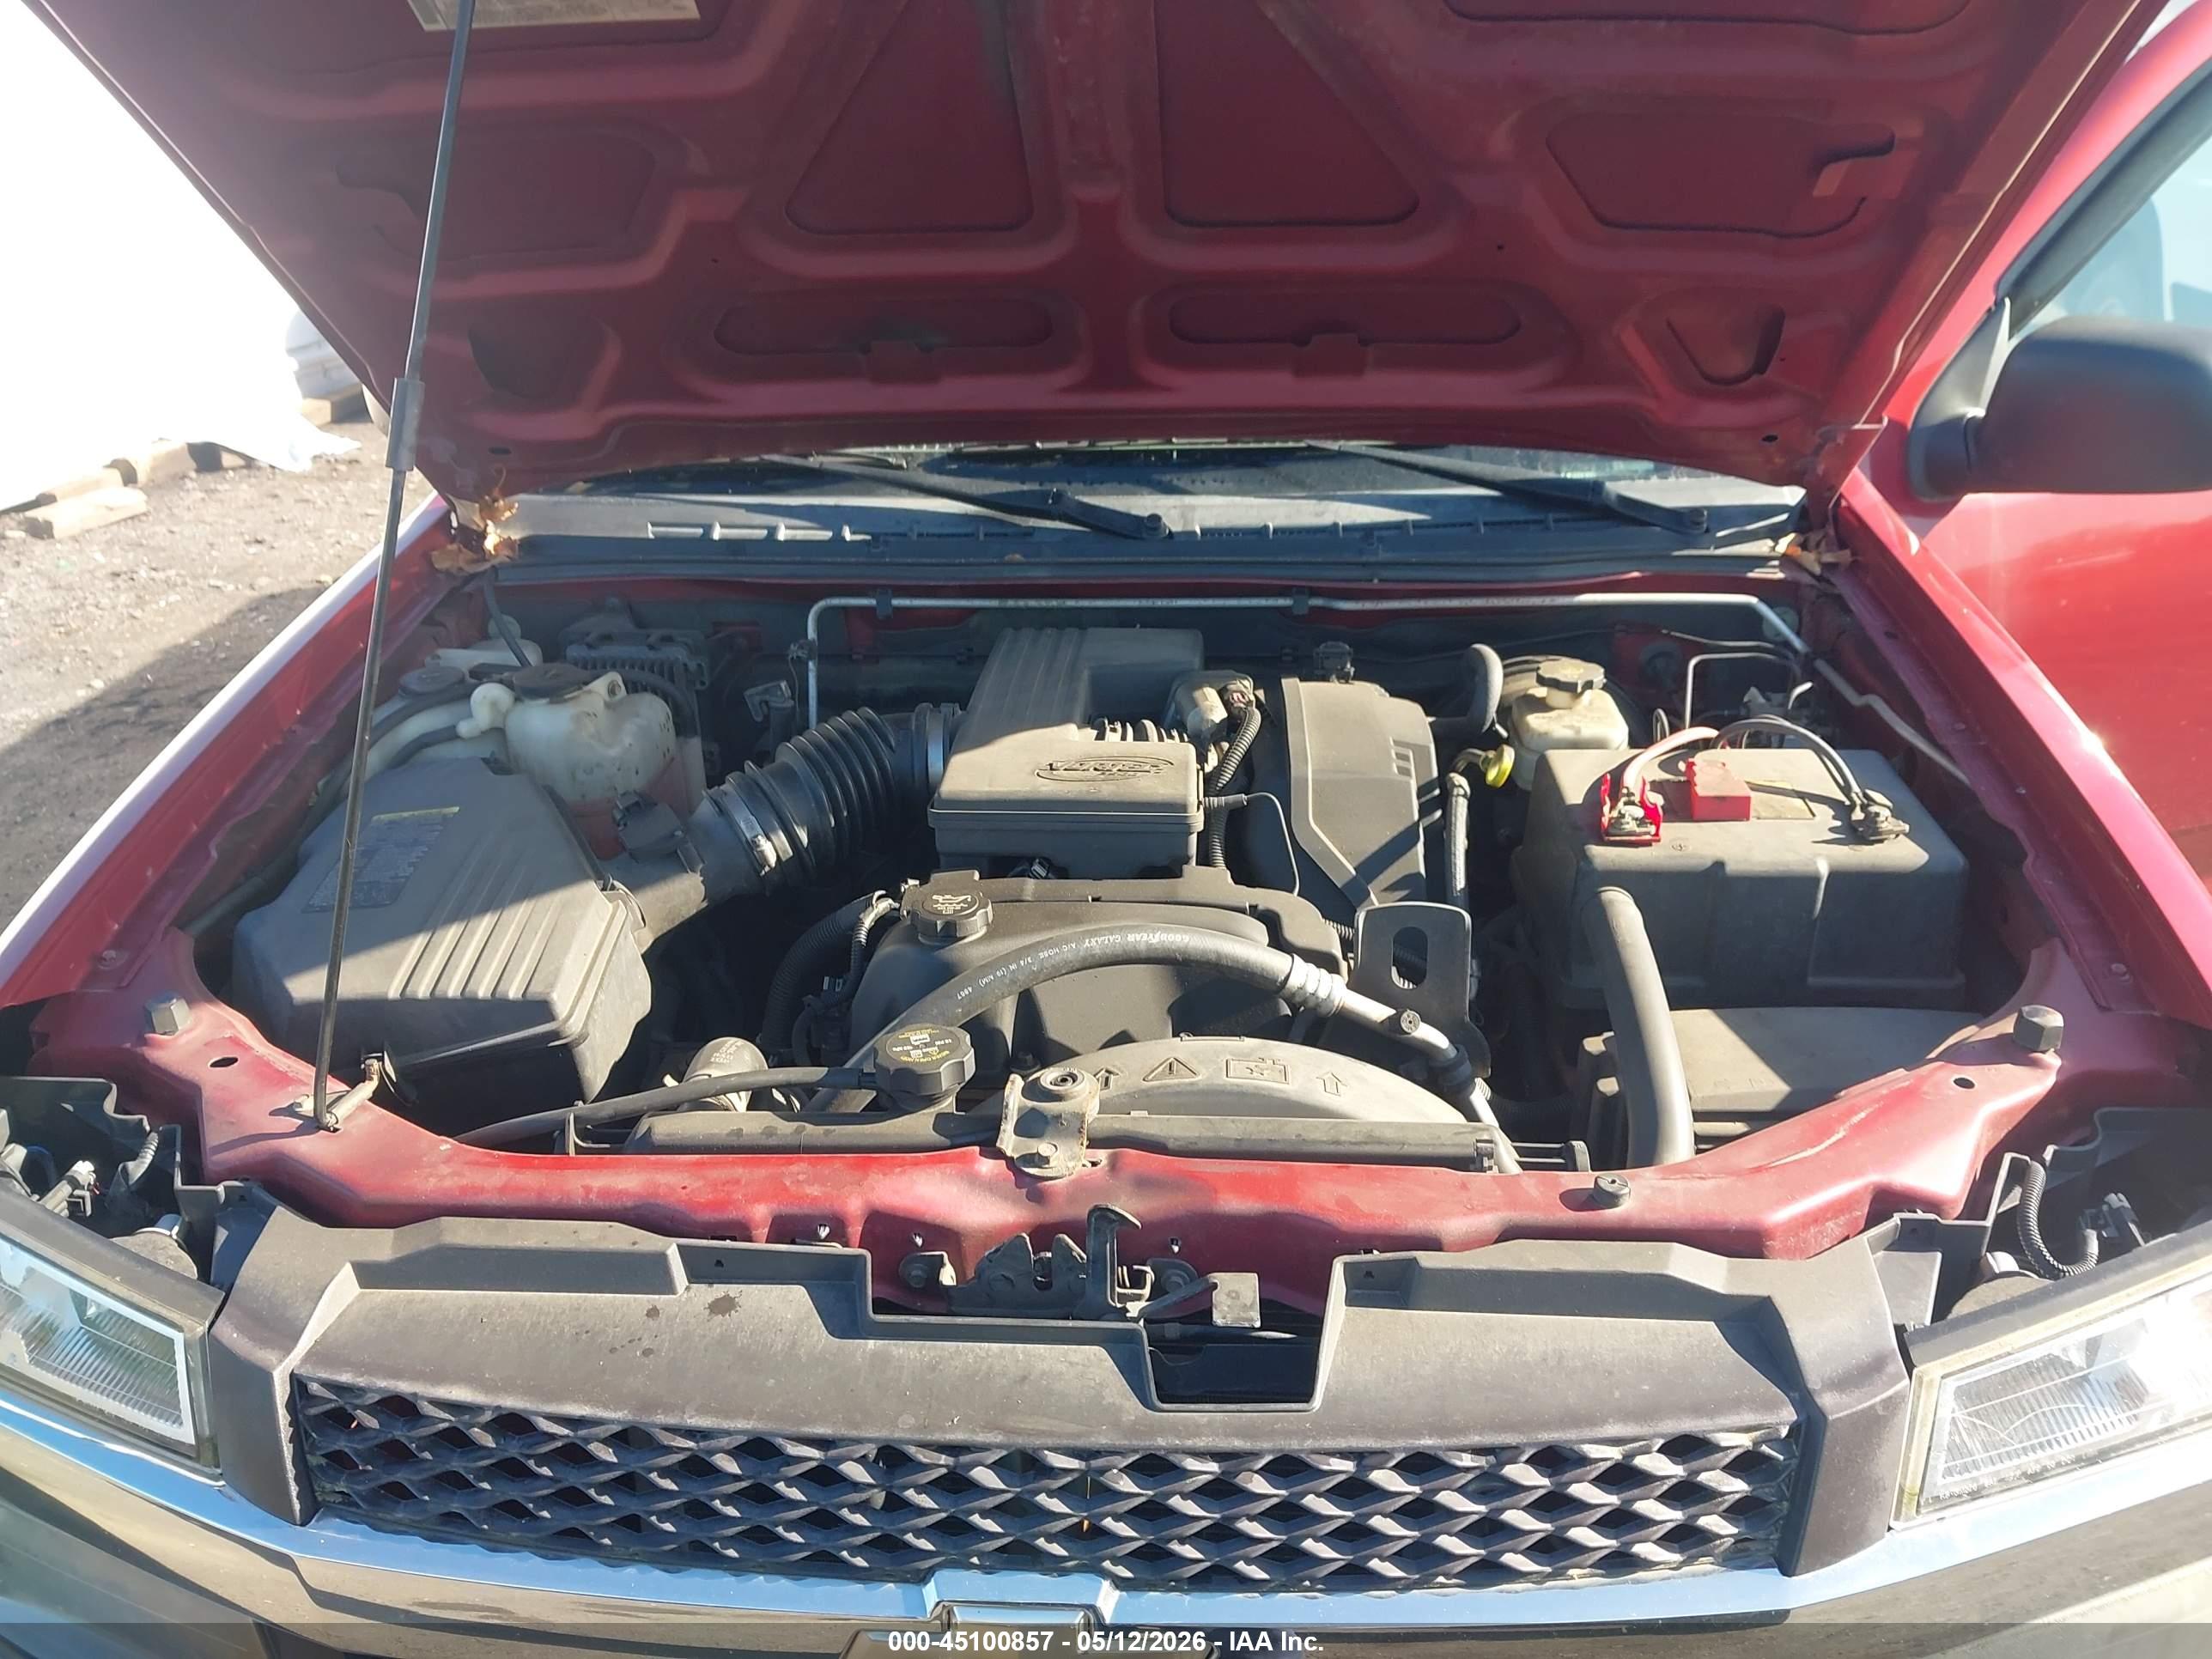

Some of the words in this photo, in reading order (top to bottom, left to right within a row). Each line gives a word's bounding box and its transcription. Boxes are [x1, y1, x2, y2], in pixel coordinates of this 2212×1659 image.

[1085, 934, 1121, 947] GALAXY
[1127, 931, 1189, 944] GOODYEAR
[1038, 946, 1060, 959] HOSE
